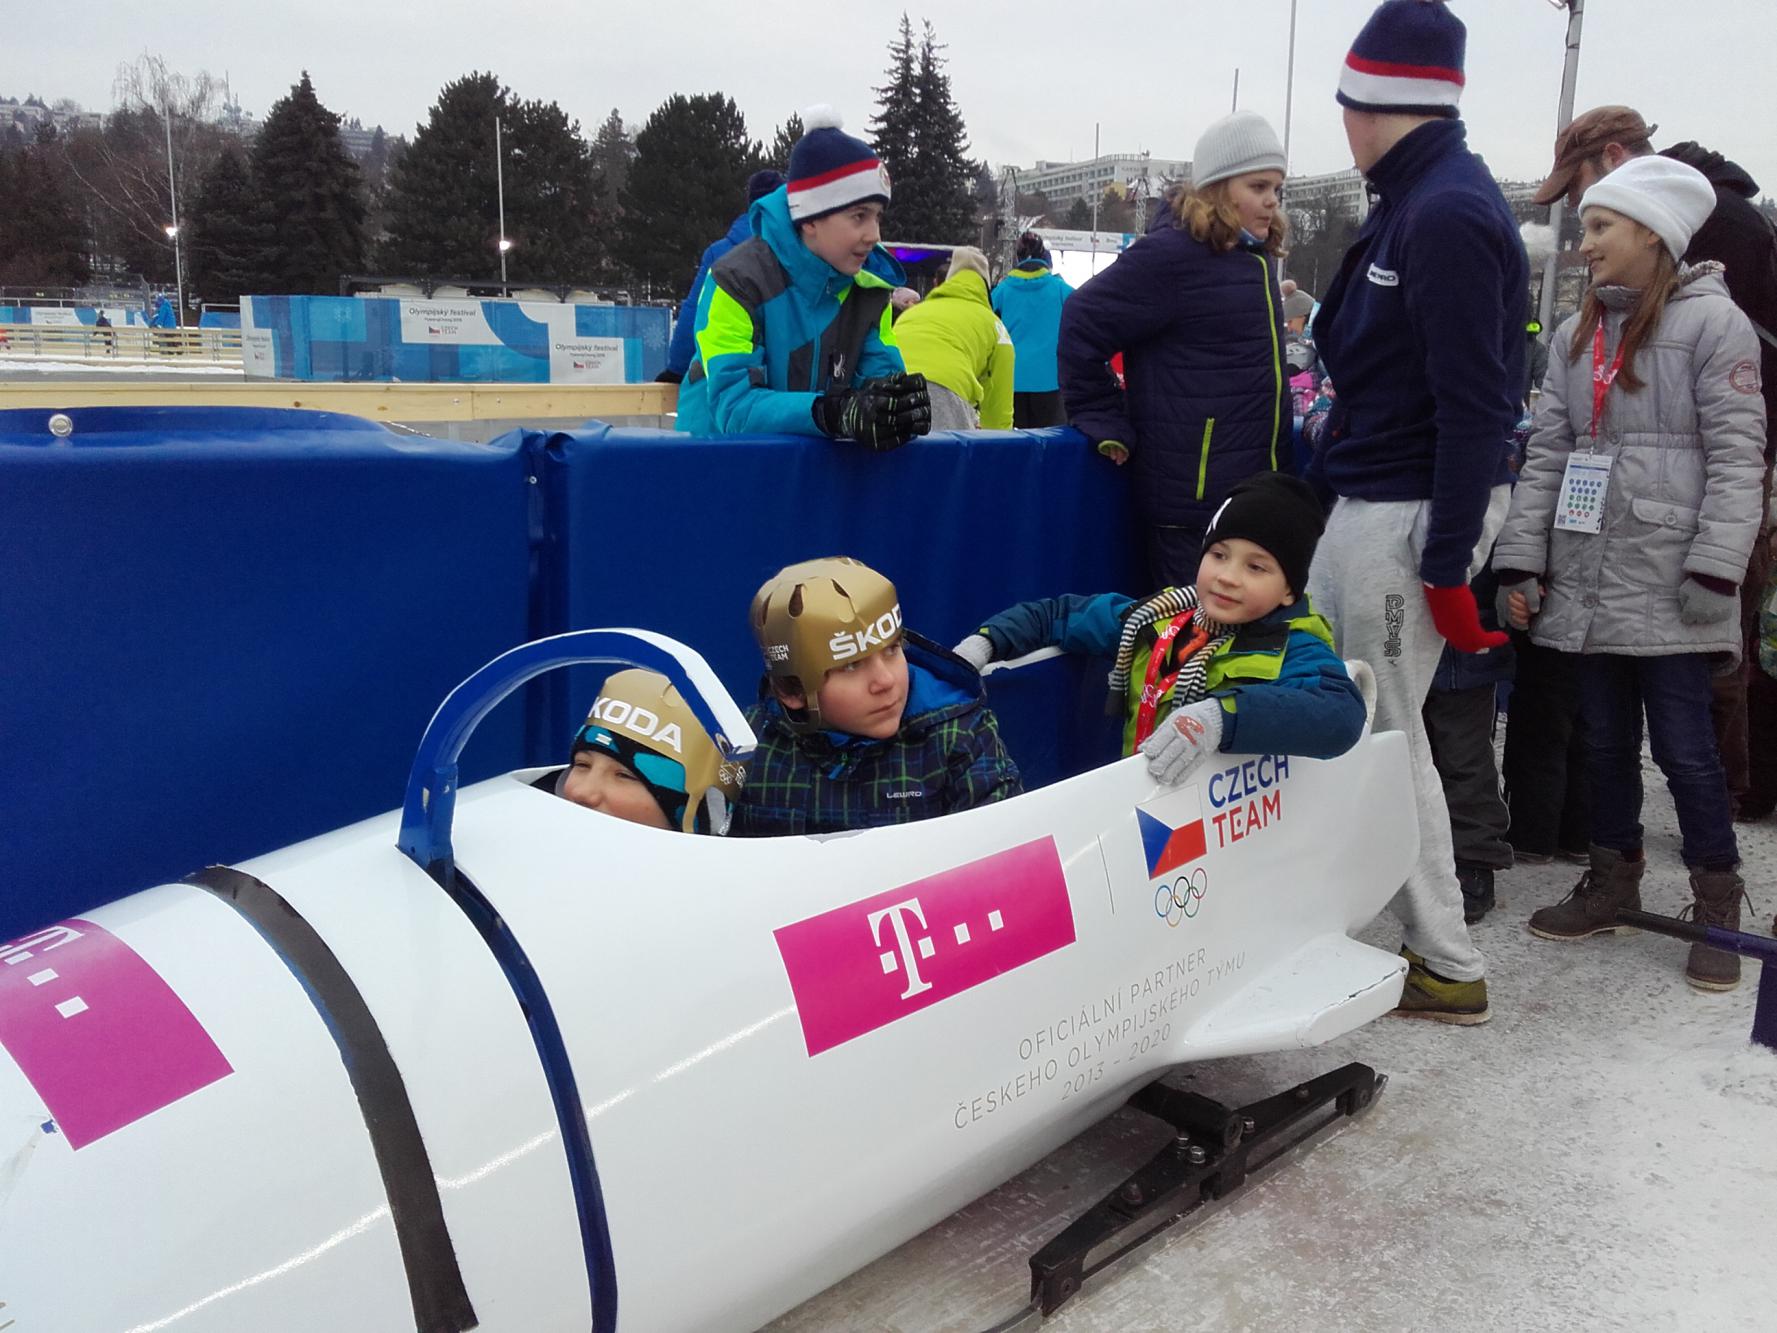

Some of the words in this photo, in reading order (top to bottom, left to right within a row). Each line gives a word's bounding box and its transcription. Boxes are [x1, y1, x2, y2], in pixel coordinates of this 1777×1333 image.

[450, 309, 476, 317] festival
[594, 344, 618, 352] festival
[1208, 753, 1289, 809] CZECH
[1212, 789, 1281, 848] TEAM
[1130, 947, 1206, 1004] PARTNER
[1060, 1060, 1105, 1101] 2013
[1127, 1023, 1171, 1062] 2020
